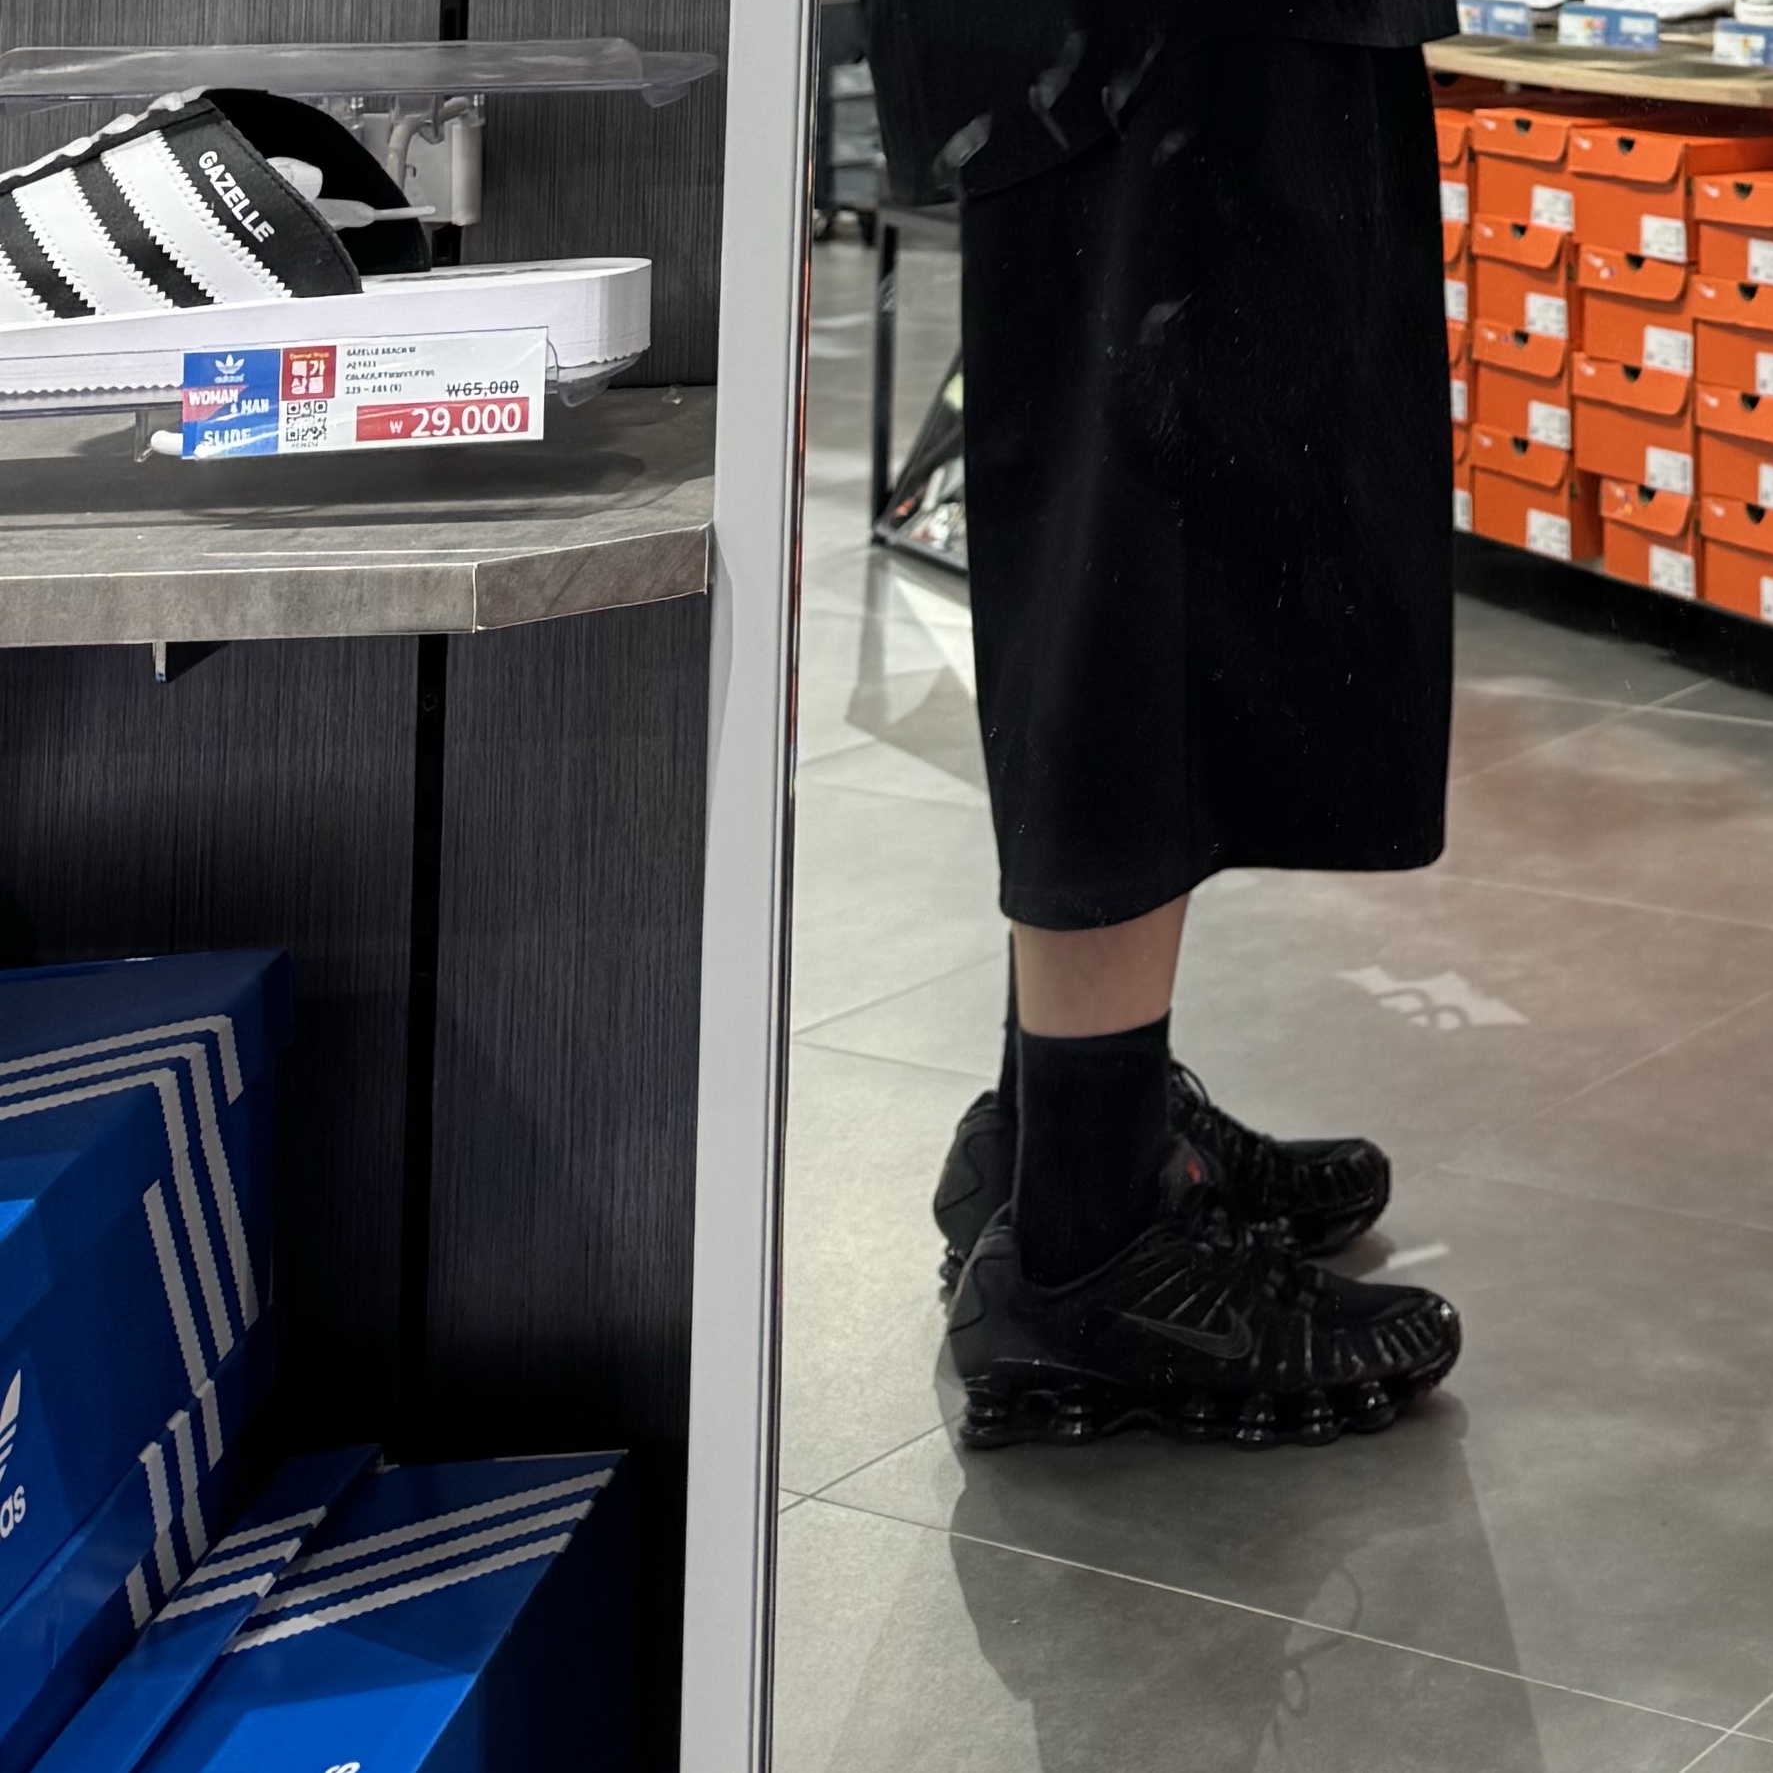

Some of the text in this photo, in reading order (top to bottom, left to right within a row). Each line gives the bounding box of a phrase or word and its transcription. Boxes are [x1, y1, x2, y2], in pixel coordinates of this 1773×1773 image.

[199, 151, 275, 243] GAZELLE
[291, 359, 326, 378] 특가
[291, 376, 326, 394] 상품
[189, 388, 239, 406] WOMAN
[240, 399, 270, 414] MAN
[410, 402, 521, 438] 29,000
[203, 429, 251, 445] SLIDE
